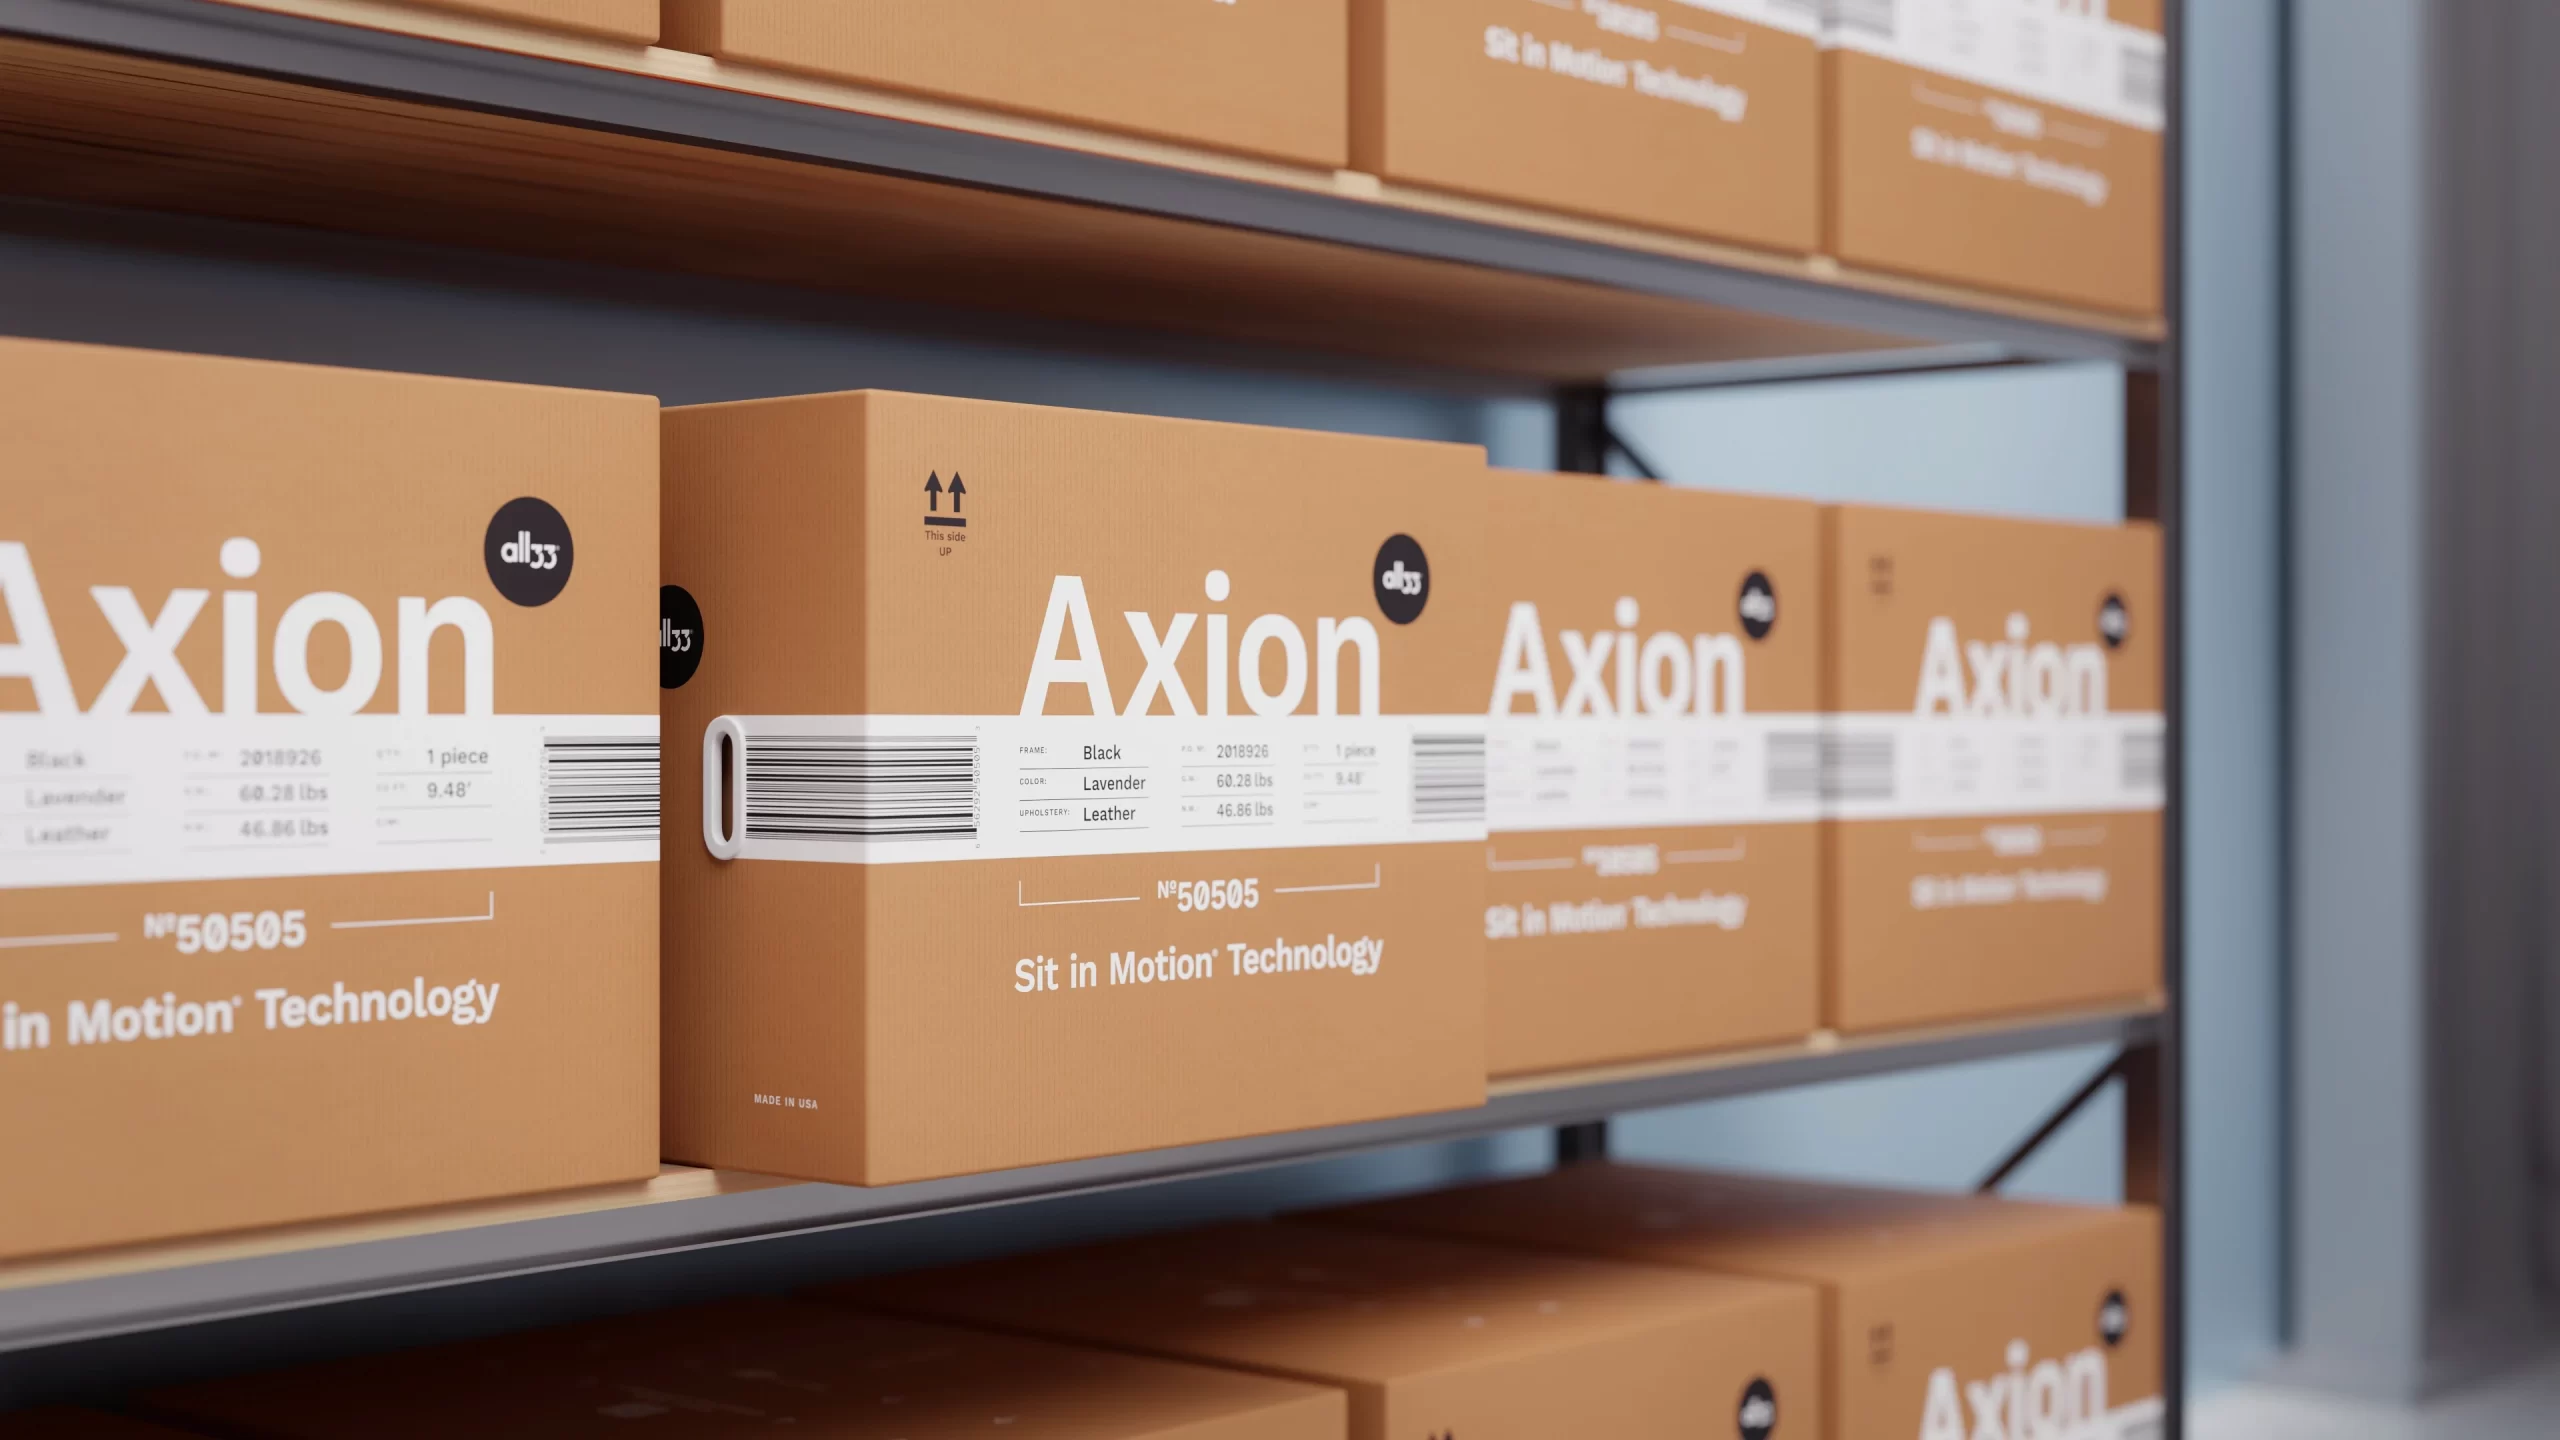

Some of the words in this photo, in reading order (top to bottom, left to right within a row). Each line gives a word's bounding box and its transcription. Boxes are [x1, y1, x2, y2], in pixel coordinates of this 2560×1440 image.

[925, 530, 944, 541] This
[947, 532, 966, 542] side
[939, 547, 952, 556] UP
[660, 618, 693, 652] ll33
[1019, 569, 1380, 715] Axion
[1488, 595, 1745, 716] Axion
[1913, 610, 2108, 716] Axion
[240, 748, 322, 768] 2018926
[441, 748, 489, 768] piece
[1020, 746, 1047, 754] FRAME:
[1084, 744, 1121, 760] Black
[1216, 744, 1269, 759] 2018926
[1084, 775, 1146, 791] Lavender
[1216, 774, 1252, 788] 60.28
[1254, 772, 1273, 787] lbs
[300, 782, 329, 802] lbs
[1020, 808, 1070, 817] UPHOLSTERY:
[1084, 806, 1136, 822] Leather
[1216, 803, 1252, 818] 46.86
[1254, 801, 1274, 817] lbs
[300, 819, 329, 837] lbs
[1014, 955, 1059, 993] Sit
[1070, 953, 1097, 989] in
[1226, 934, 1384, 976] Technology
[2, 1001, 50, 1050] in
[254, 975, 500, 1029] Technology
[754, 1094, 781, 1106] MADE
[785, 1096, 795, 1107] IN
[798, 1098, 818, 1110] USA
[1915, 1336, 2108, 1440] Axion
